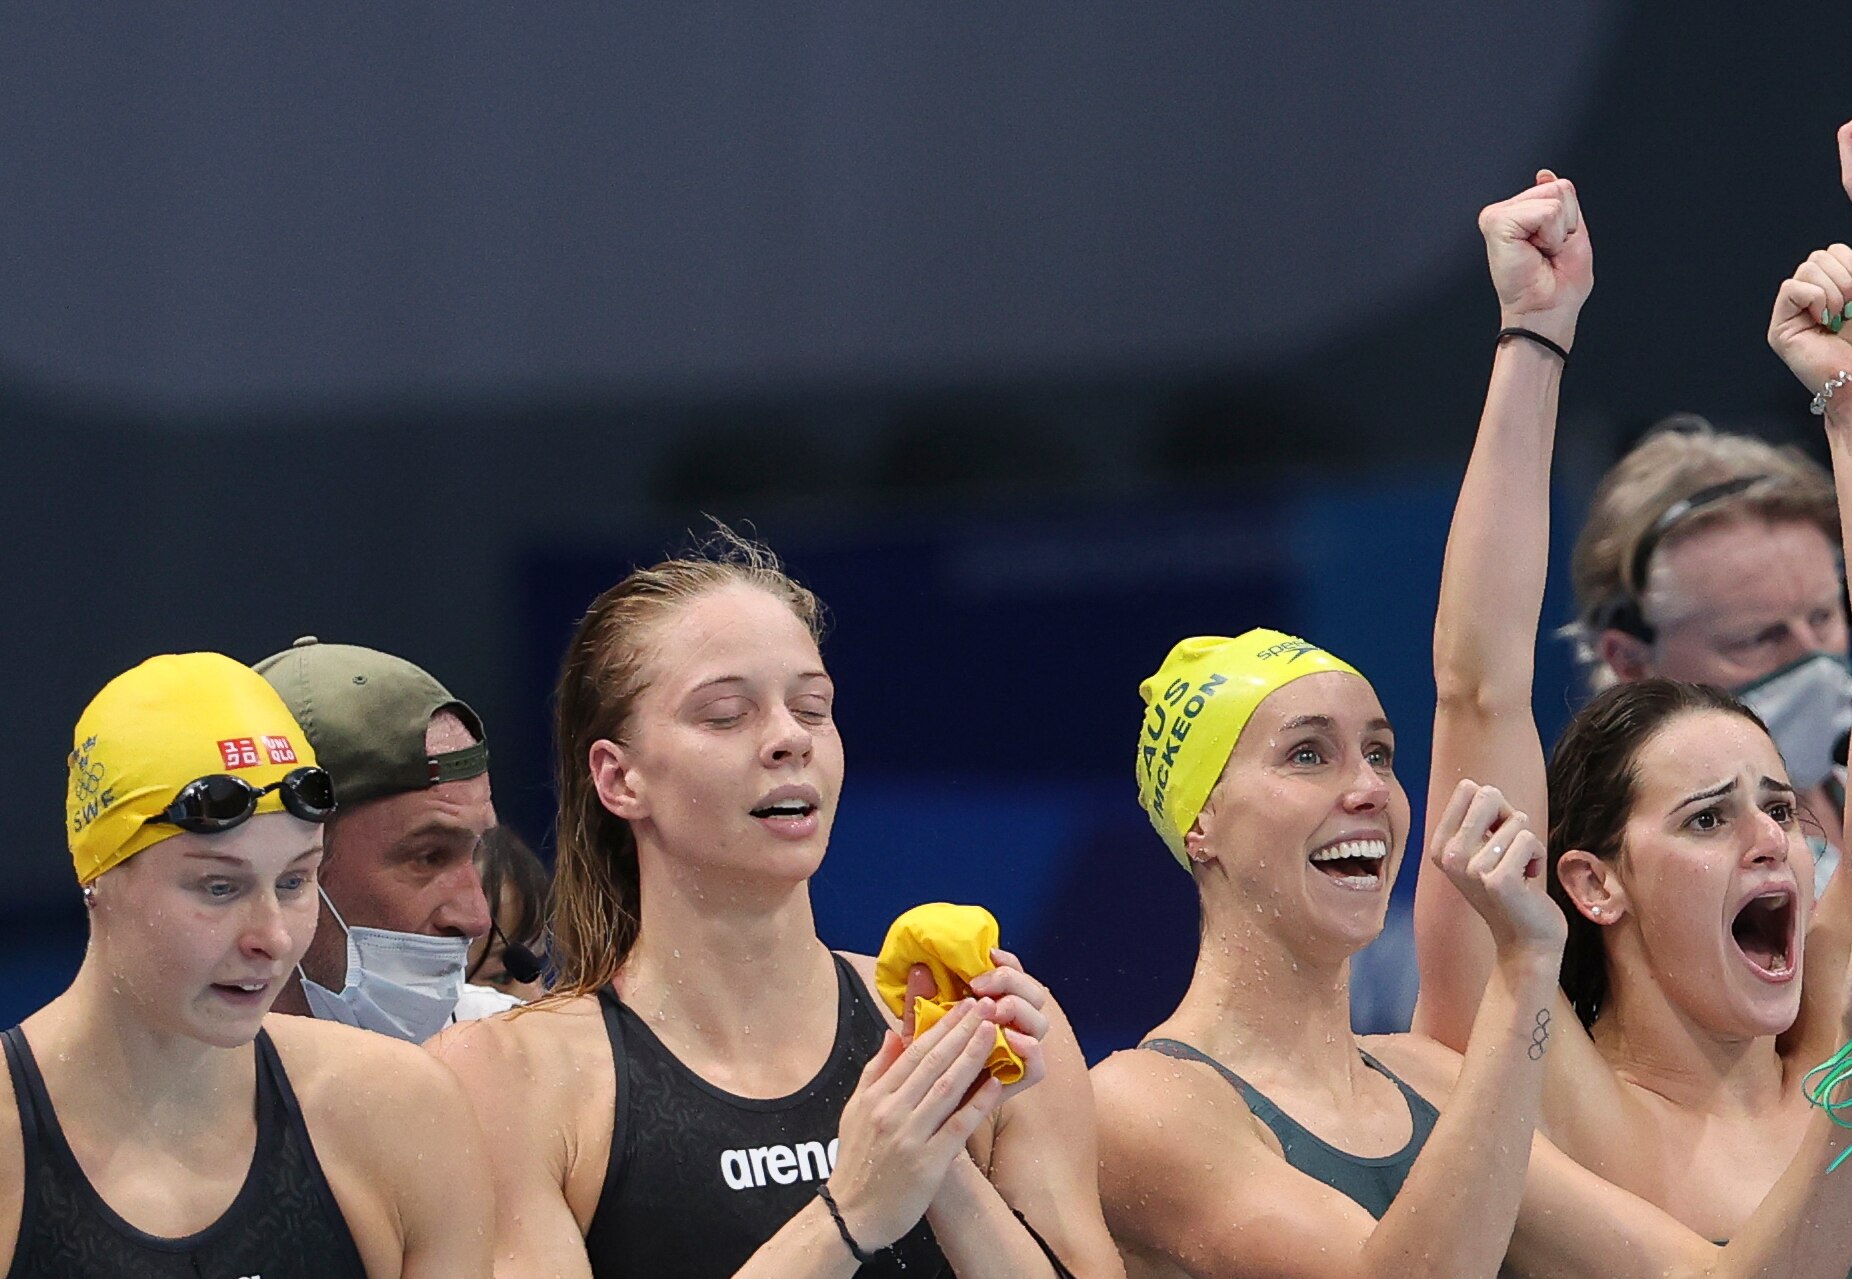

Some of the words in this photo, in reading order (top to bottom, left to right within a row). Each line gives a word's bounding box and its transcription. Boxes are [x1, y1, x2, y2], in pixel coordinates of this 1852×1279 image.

[267, 738, 289, 749] UNI
[271, 749, 295, 762] QLO
[1142, 678, 1190, 783] AUS
[1153, 674, 1228, 818] MCKEON
